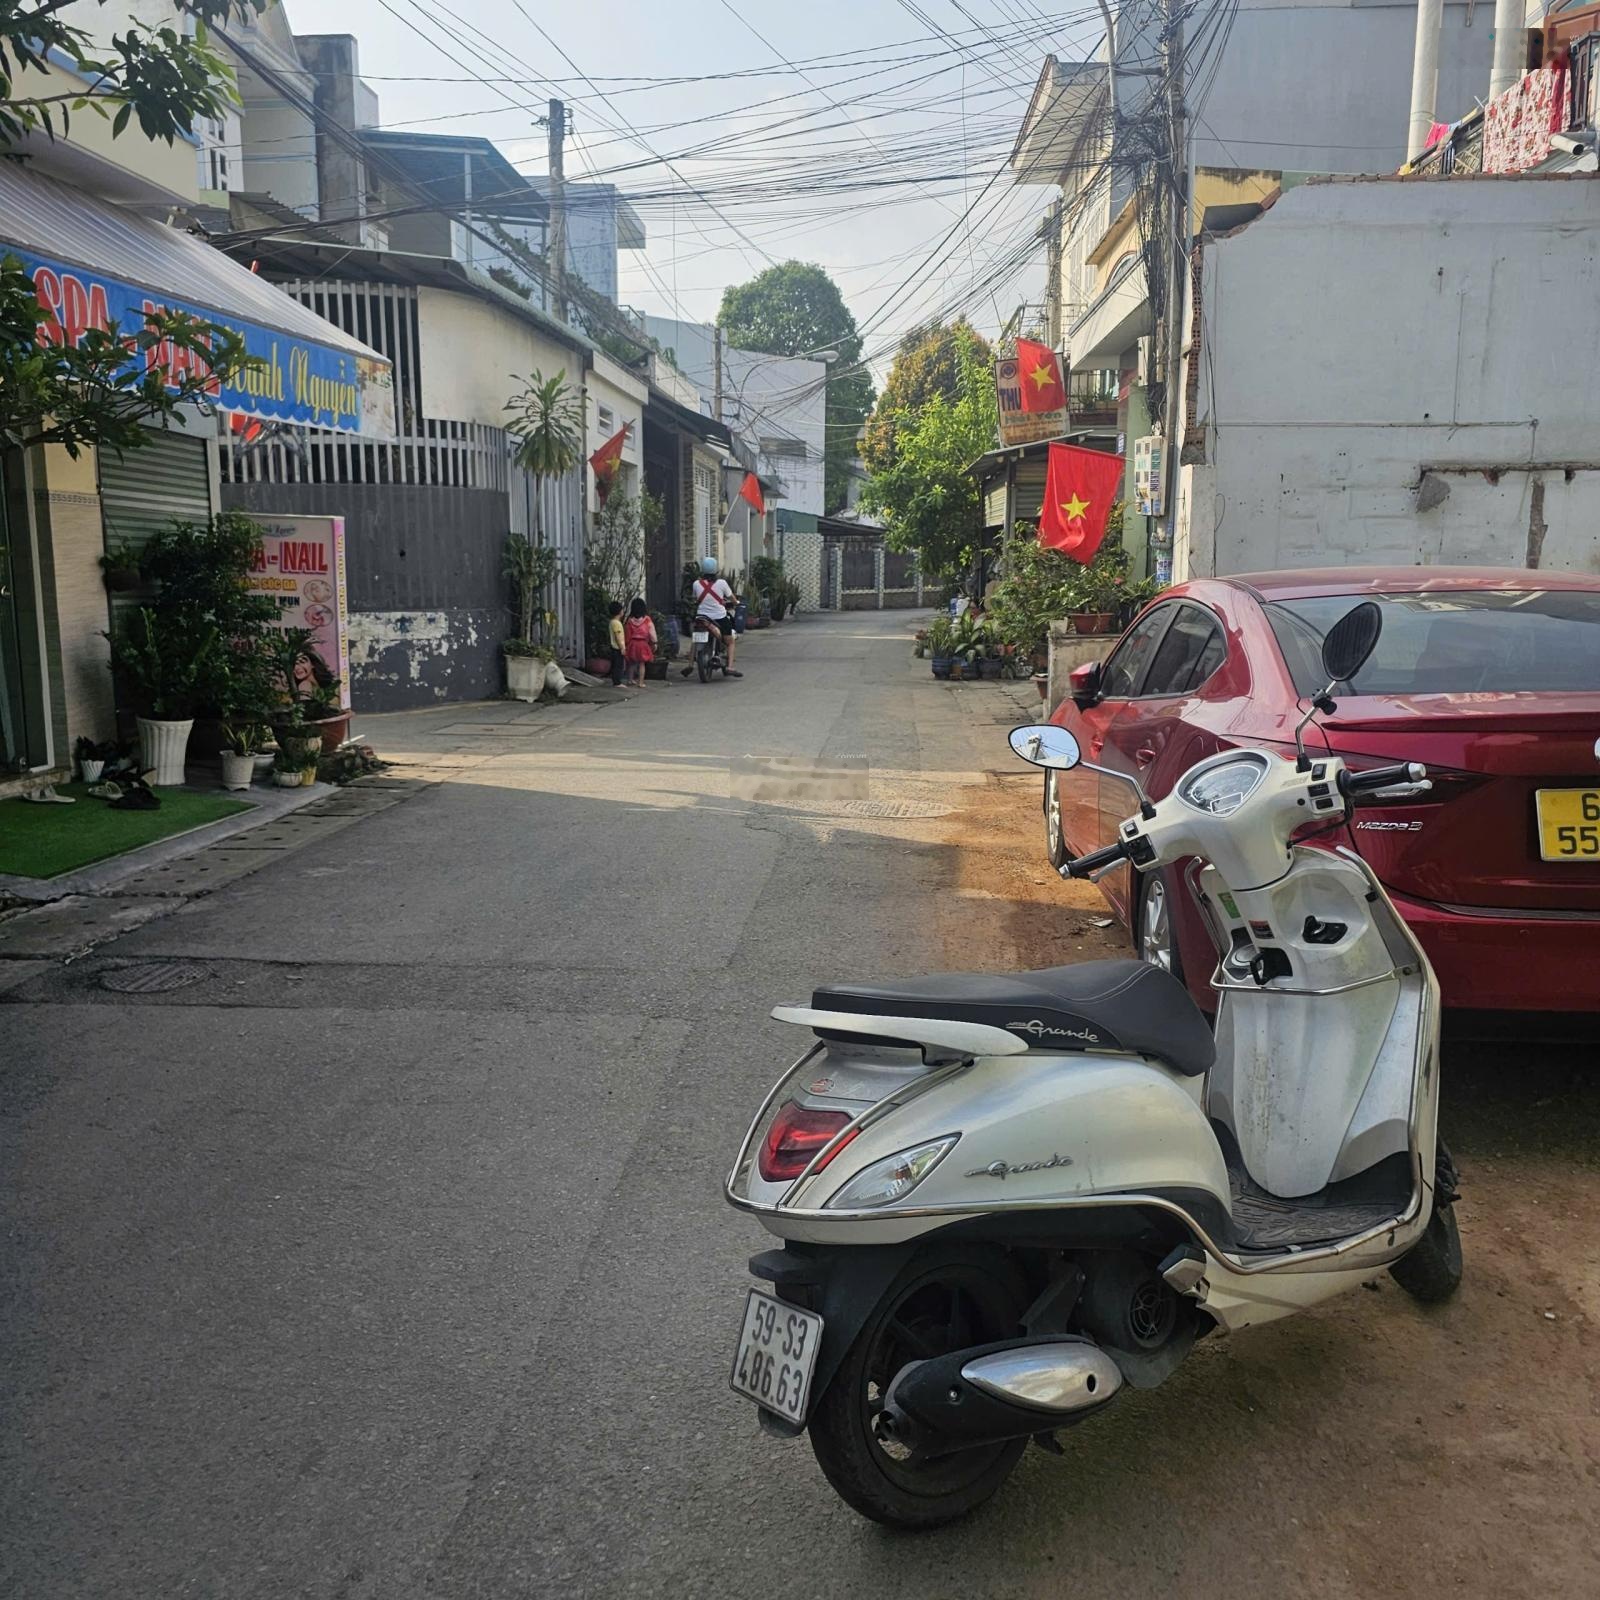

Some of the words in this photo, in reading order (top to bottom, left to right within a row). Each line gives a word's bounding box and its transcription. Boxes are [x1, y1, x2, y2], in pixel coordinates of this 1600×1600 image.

[32, 266, 113, 358] SPA
[281, 541, 328, 573] NAIL
[1006, 1020, 1099, 1043] Grande
[963, 1153, 1074, 1180] Grande
[751, 1299, 808, 1361] 59-S3
[738, 1344, 804, 1413] 486.63
